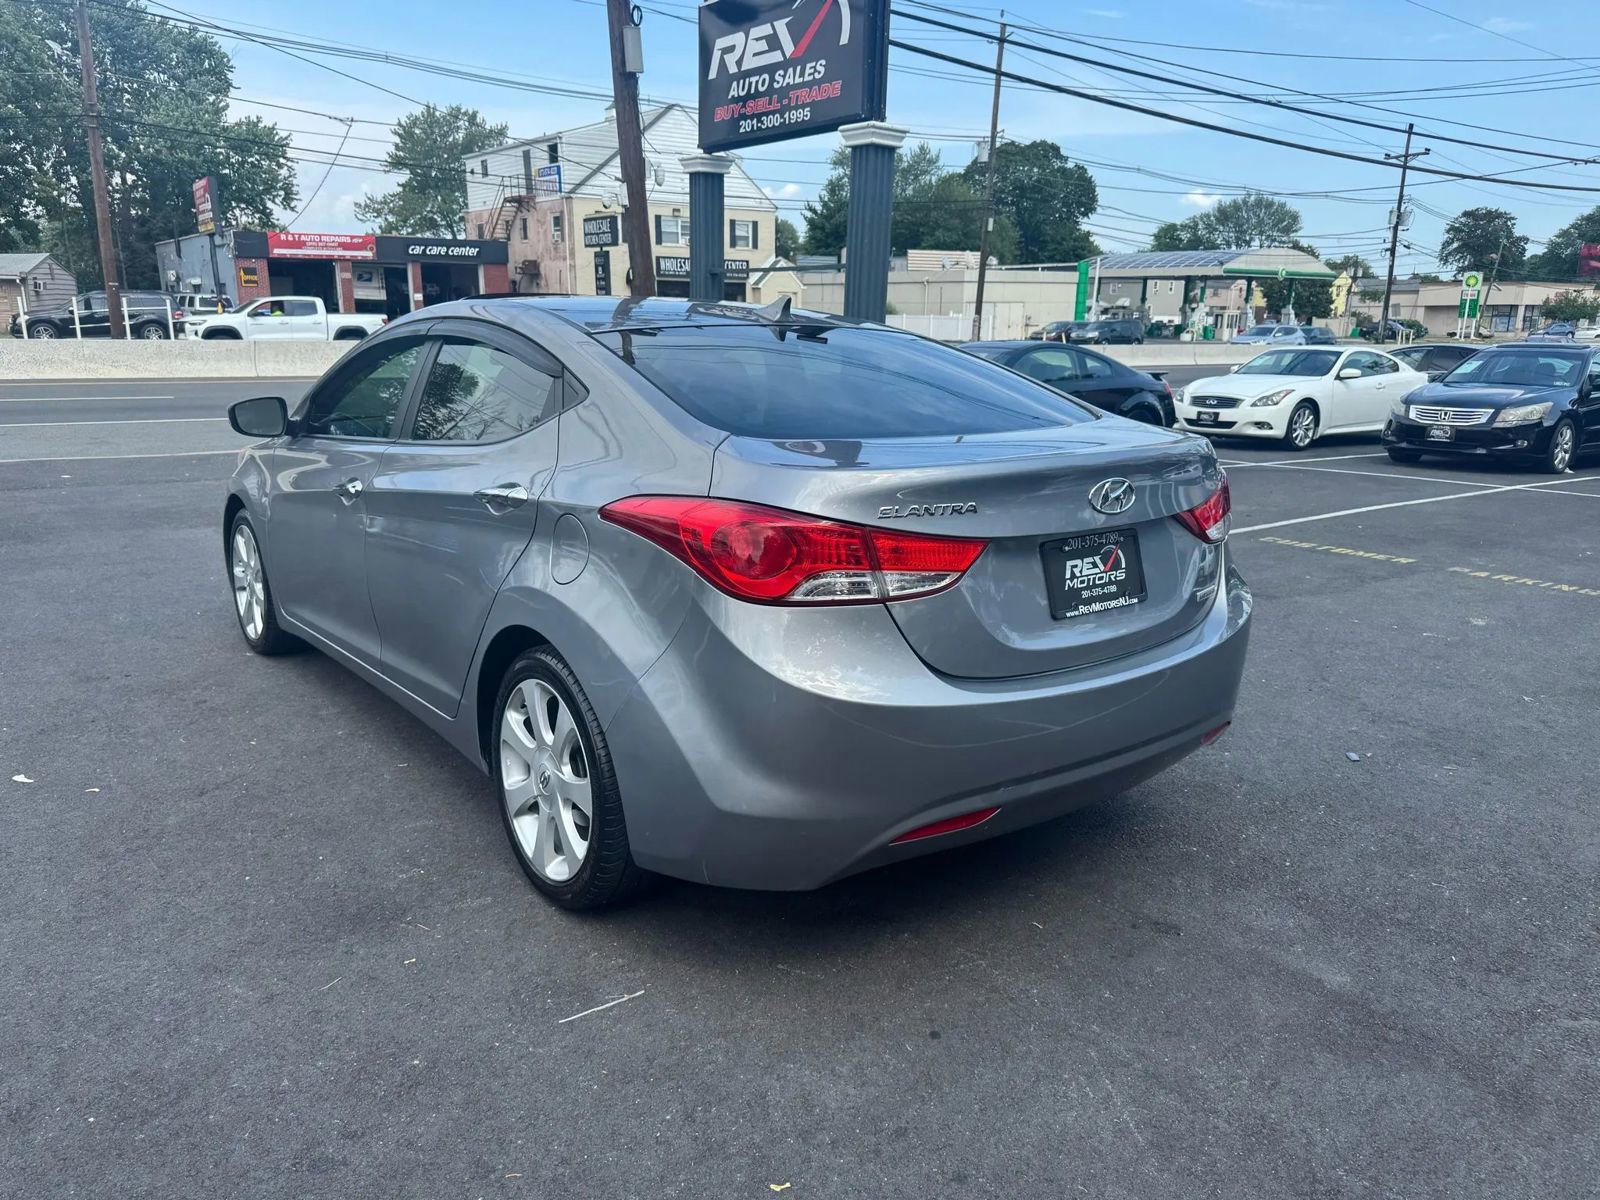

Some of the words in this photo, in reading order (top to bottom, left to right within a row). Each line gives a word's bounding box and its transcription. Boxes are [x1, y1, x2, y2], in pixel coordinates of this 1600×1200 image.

[728, 73, 769, 99] AUTO
[773, 59, 826, 89] SALES
[739, 107, 811, 133] 201-300-1995
[585, 218, 611, 234] WHOLESALE
[280, 233, 287, 241] R
[300, 234, 320, 242] AUTO
[321, 235, 351, 243] REPAIRS
[585, 234, 598, 245] KITCHEN
[598, 233, 612, 244] CENTER
[408, 245, 424, 255] car
[425, 245, 447, 256] care
[448, 246, 479, 257] center
[878, 502, 977, 519] ELANTRA
[1067, 532, 1118, 550] 201-375-4789
[1065, 548, 1114, 579] REV
[1065, 569, 1125, 590] MOTORS
